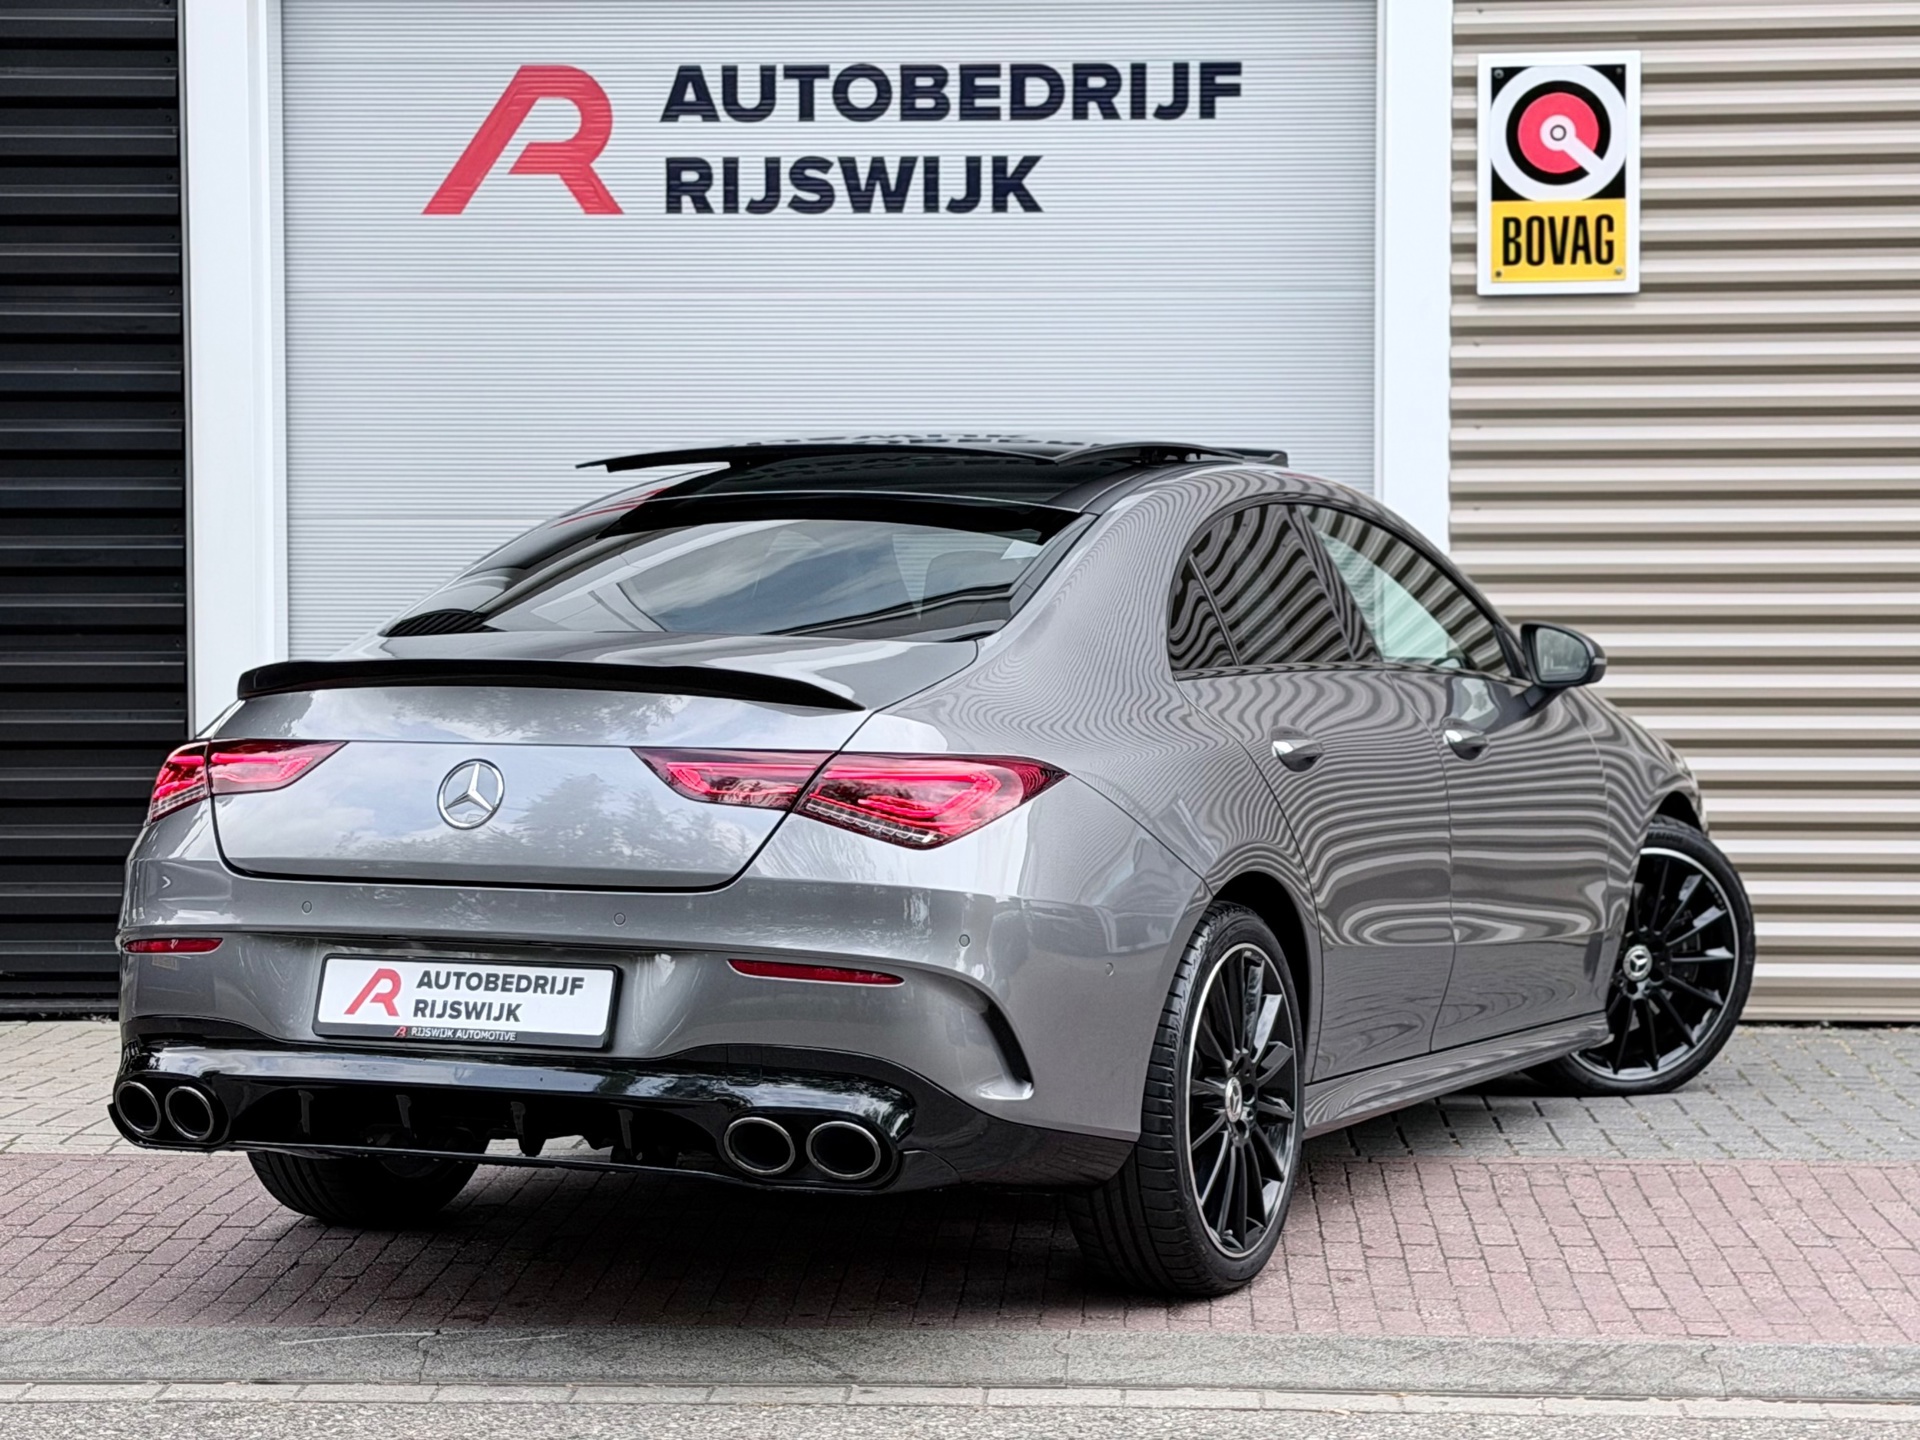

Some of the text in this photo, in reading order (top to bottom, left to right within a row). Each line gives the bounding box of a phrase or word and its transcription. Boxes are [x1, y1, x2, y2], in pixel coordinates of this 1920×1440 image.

[660, 61, 1243, 122] AUTOBEDRIJF
[664, 155, 1044, 215] RIJSWIJK
[1502, 213, 1615, 266] BOVAG
[416, 970, 584, 996] AUTOBEDRIJF
[413, 999, 522, 1022] RIJSWIJK
[411, 1027, 455, 1038] RIJSWIJK
[455, 1030, 517, 1042] AUTOMOTIVE
